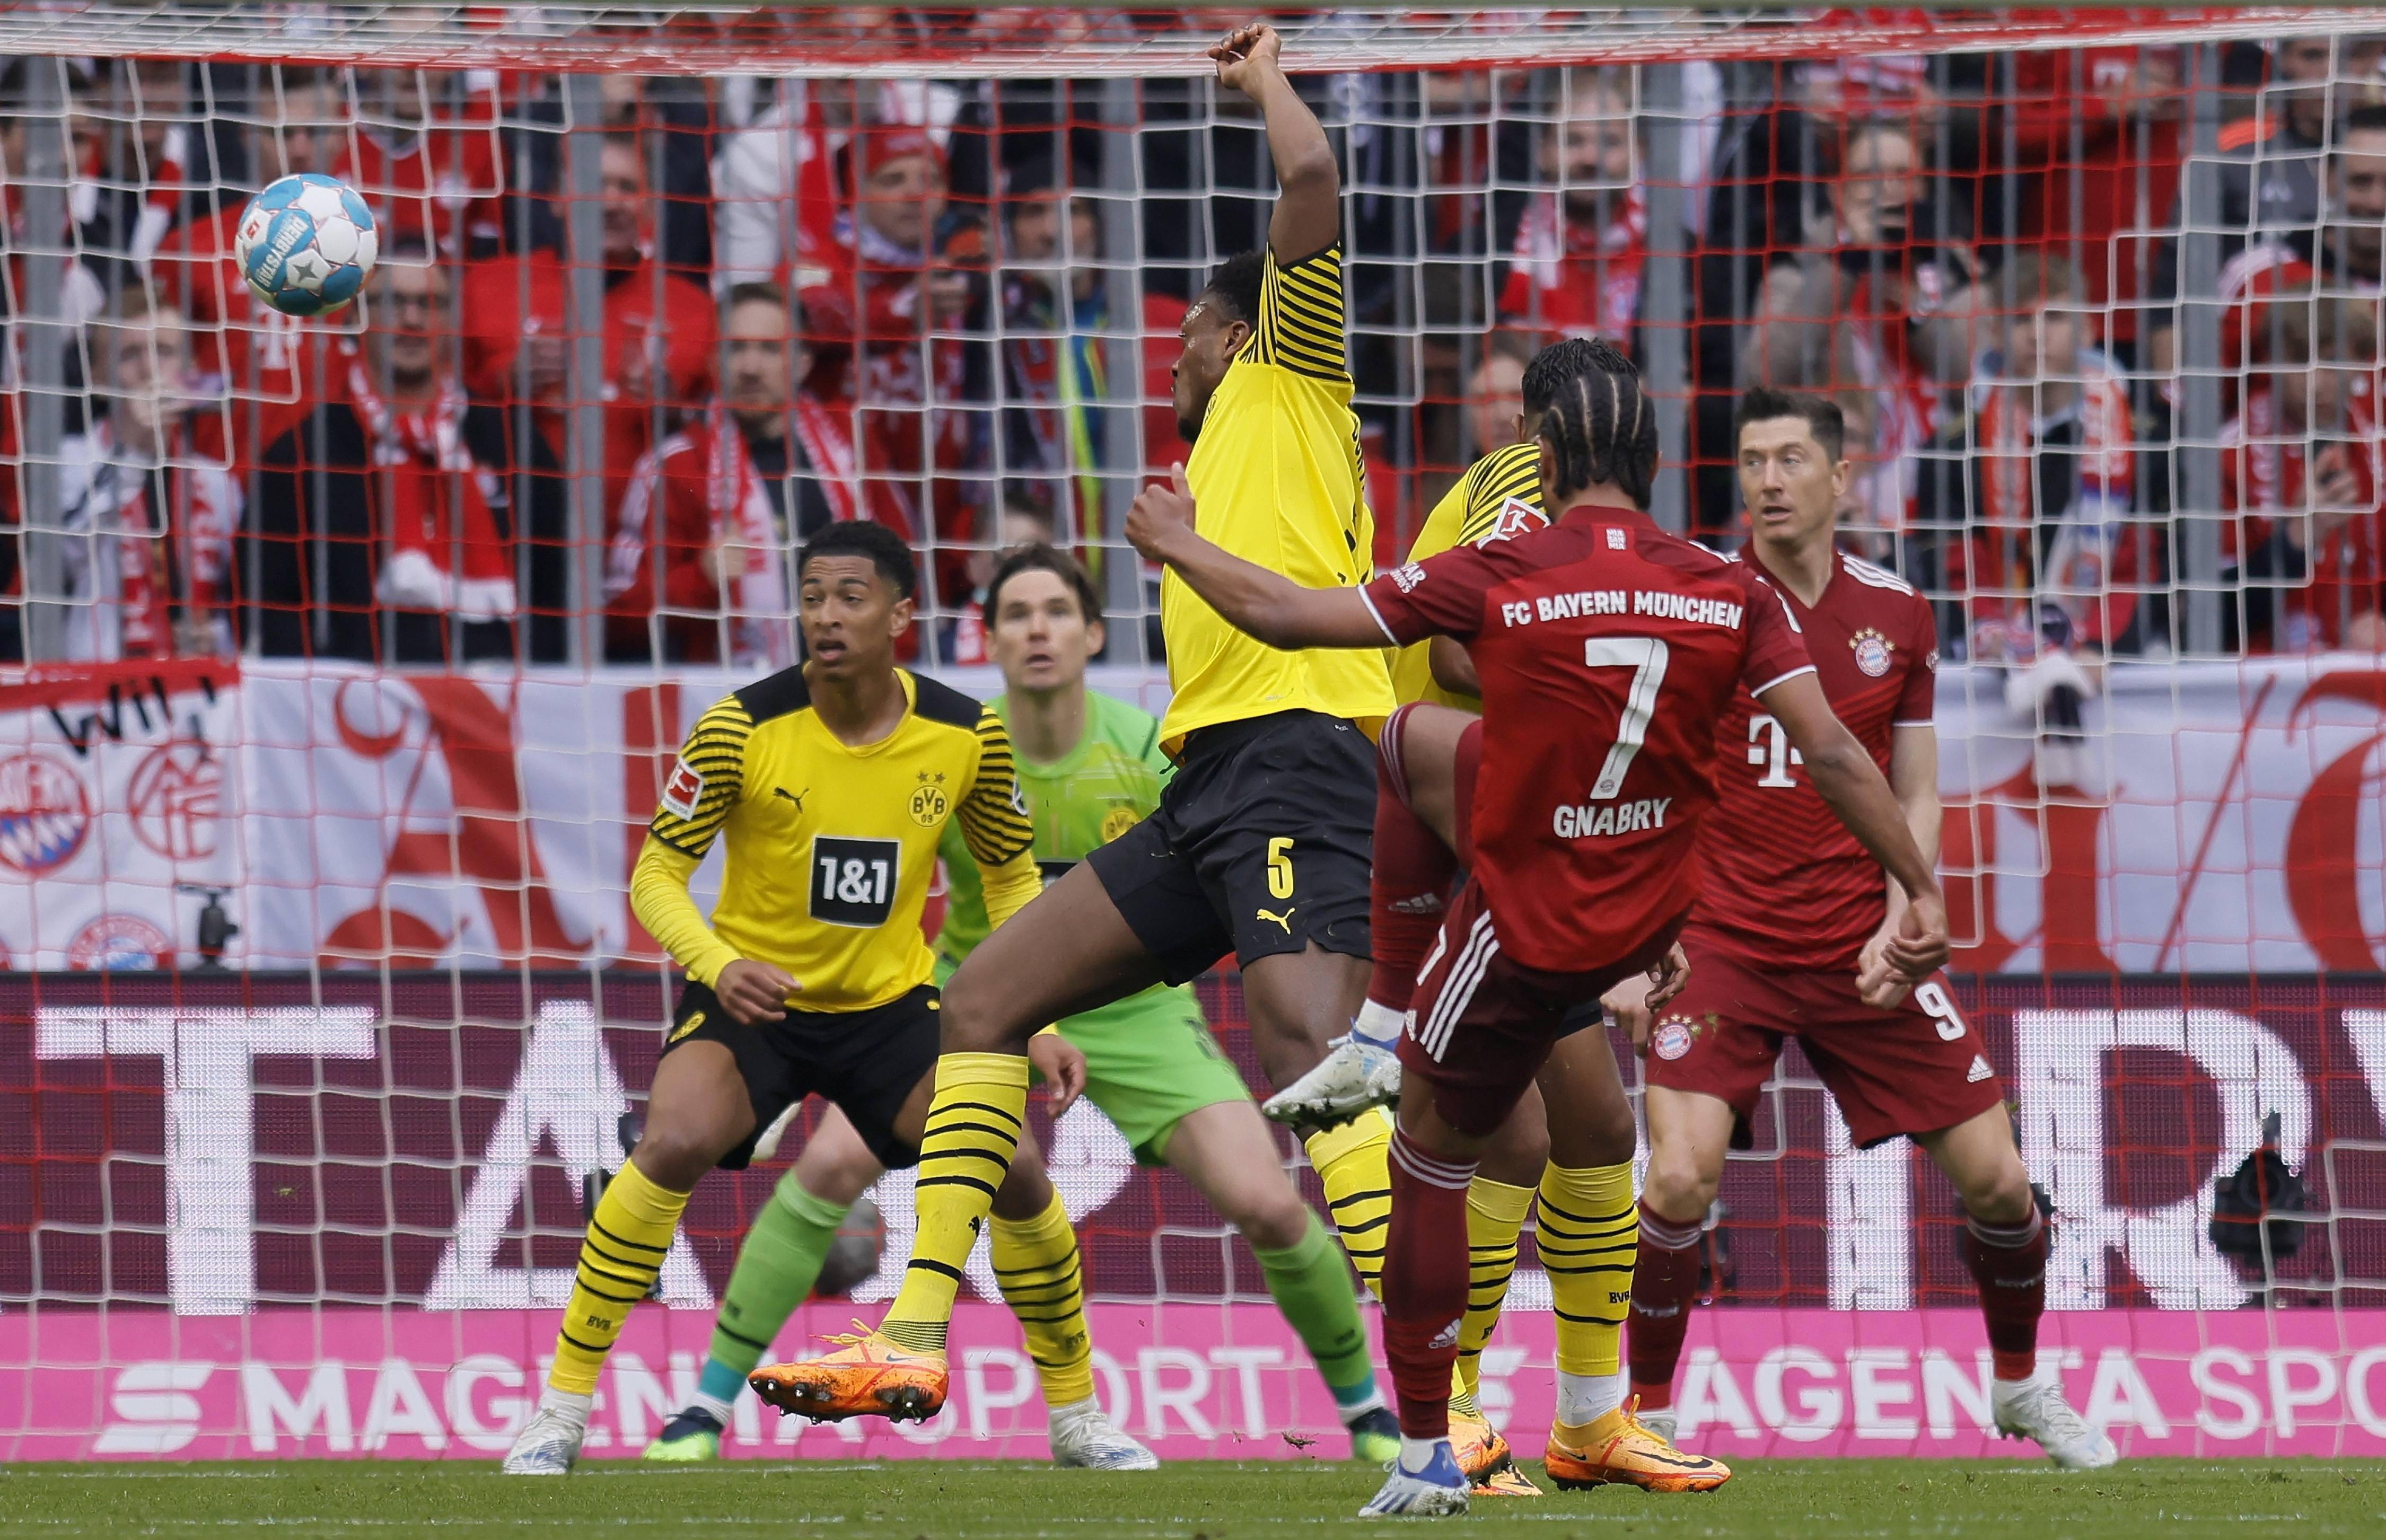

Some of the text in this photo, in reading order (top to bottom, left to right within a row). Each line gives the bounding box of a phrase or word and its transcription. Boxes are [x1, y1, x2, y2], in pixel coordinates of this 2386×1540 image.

[255, 216, 309, 288] DERBYSTAR
[1502, 590, 1743, 630] FC BAYERN MÜNCHEN
[1585, 638, 1669, 799] 7
[913, 789, 945, 814] BVB
[1554, 797, 1673, 839] GNABRY
[820, 857, 888, 904] 1&1
[1267, 837, 1295, 900] 5
[1915, 983, 1967, 1041] 9
[1609, 1290, 1630, 1304] BVB
[1617, 1345, 2169, 1441] AGENTA
